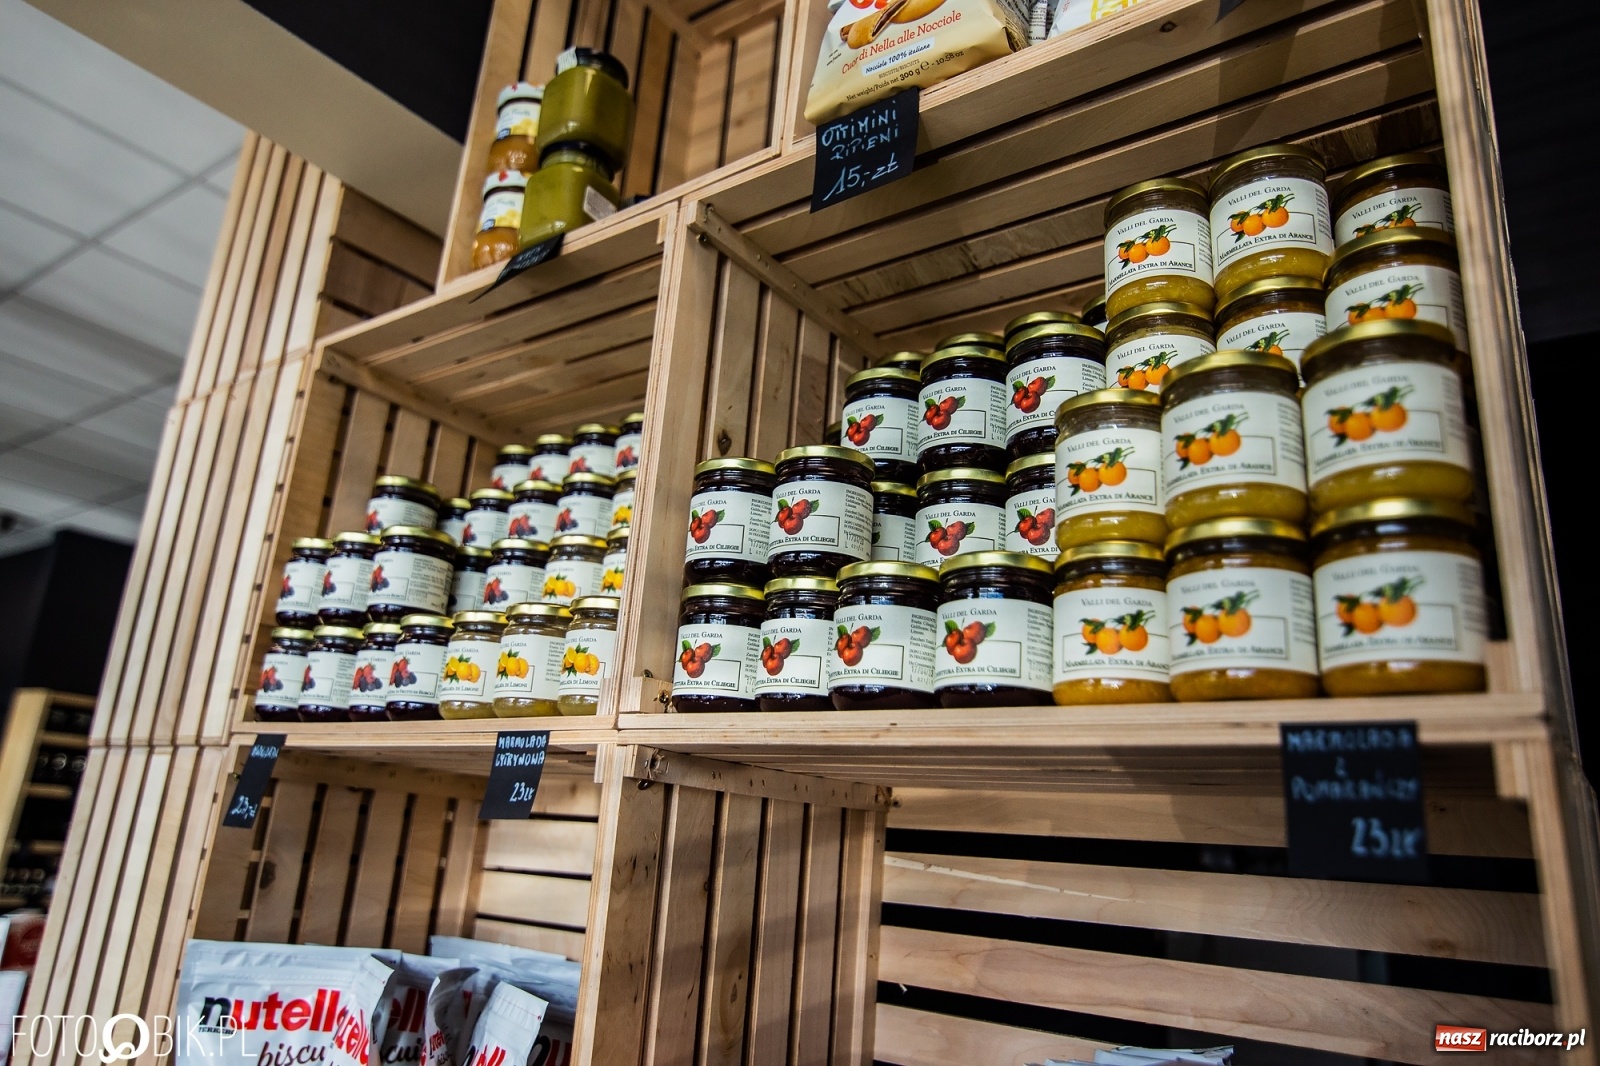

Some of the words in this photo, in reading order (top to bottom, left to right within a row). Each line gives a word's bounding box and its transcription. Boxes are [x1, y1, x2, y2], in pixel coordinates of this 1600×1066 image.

[841, 58, 860, 75] Cuor
[860, 49, 868, 61] di
[870, 37, 896, 57] Nella
[897, 30, 916, 45] alle
[917, 10, 962, 36] Nocciole
[865, 62, 888, 74] Nocciole
[888, 52, 907, 64] 100%
[846, 92, 857, 101] Net
[890, 76, 900, 85] net
[900, 70, 914, 81] 300
[914, 68, 921, 76] g
[935, 52, 955, 66] 10.58
[955, 50, 965, 58] oz
[1228, 196, 1247, 206] VALLI
[1248, 190, 1262, 198] DEL
[1264, 186, 1292, 194] GARDA
[1352, 208, 1372, 220] VALLI
[1373, 202, 1388, 210] DEL
[1389, 196, 1418, 206] GARDA
[1117, 225, 1134, 236] VALLI
[1134, 220, 1148, 228] DEL
[1254, 235, 1277, 244] EXTRA
[1288, 232, 1313, 240] ARANCE
[1137, 262, 1158, 270] EXTRA
[1168, 260, 1193, 268] ARANCE
[1387, 275, 1420, 284] GARDA
[1226, 333, 1242, 345] VALLI
[1258, 322, 1286, 332] GARDA
[1116, 350, 1133, 360] VALLI
[1134, 346, 1146, 354] DEL
[1009, 373, 1021, 383] VALLI
[1033, 365, 1056, 374] GARDA
[1023, 413, 1040, 421] EXTRA
[1067, 442, 1085, 453] VALLI
[1014, 500, 1028, 510] VALLI
[925, 512, 938, 520] VALLI
[1030, 546, 1050, 554] EXTRA
[1123, 597, 1153, 607] GARDA
[858, 613, 883, 621] GARDA
[957, 610, 968, 618] DEL
[970, 607, 998, 616] GARDA
[780, 626, 802, 634] GARDA
[843, 667, 861, 675] EXTRA
[955, 666, 976, 675] EXTRA
